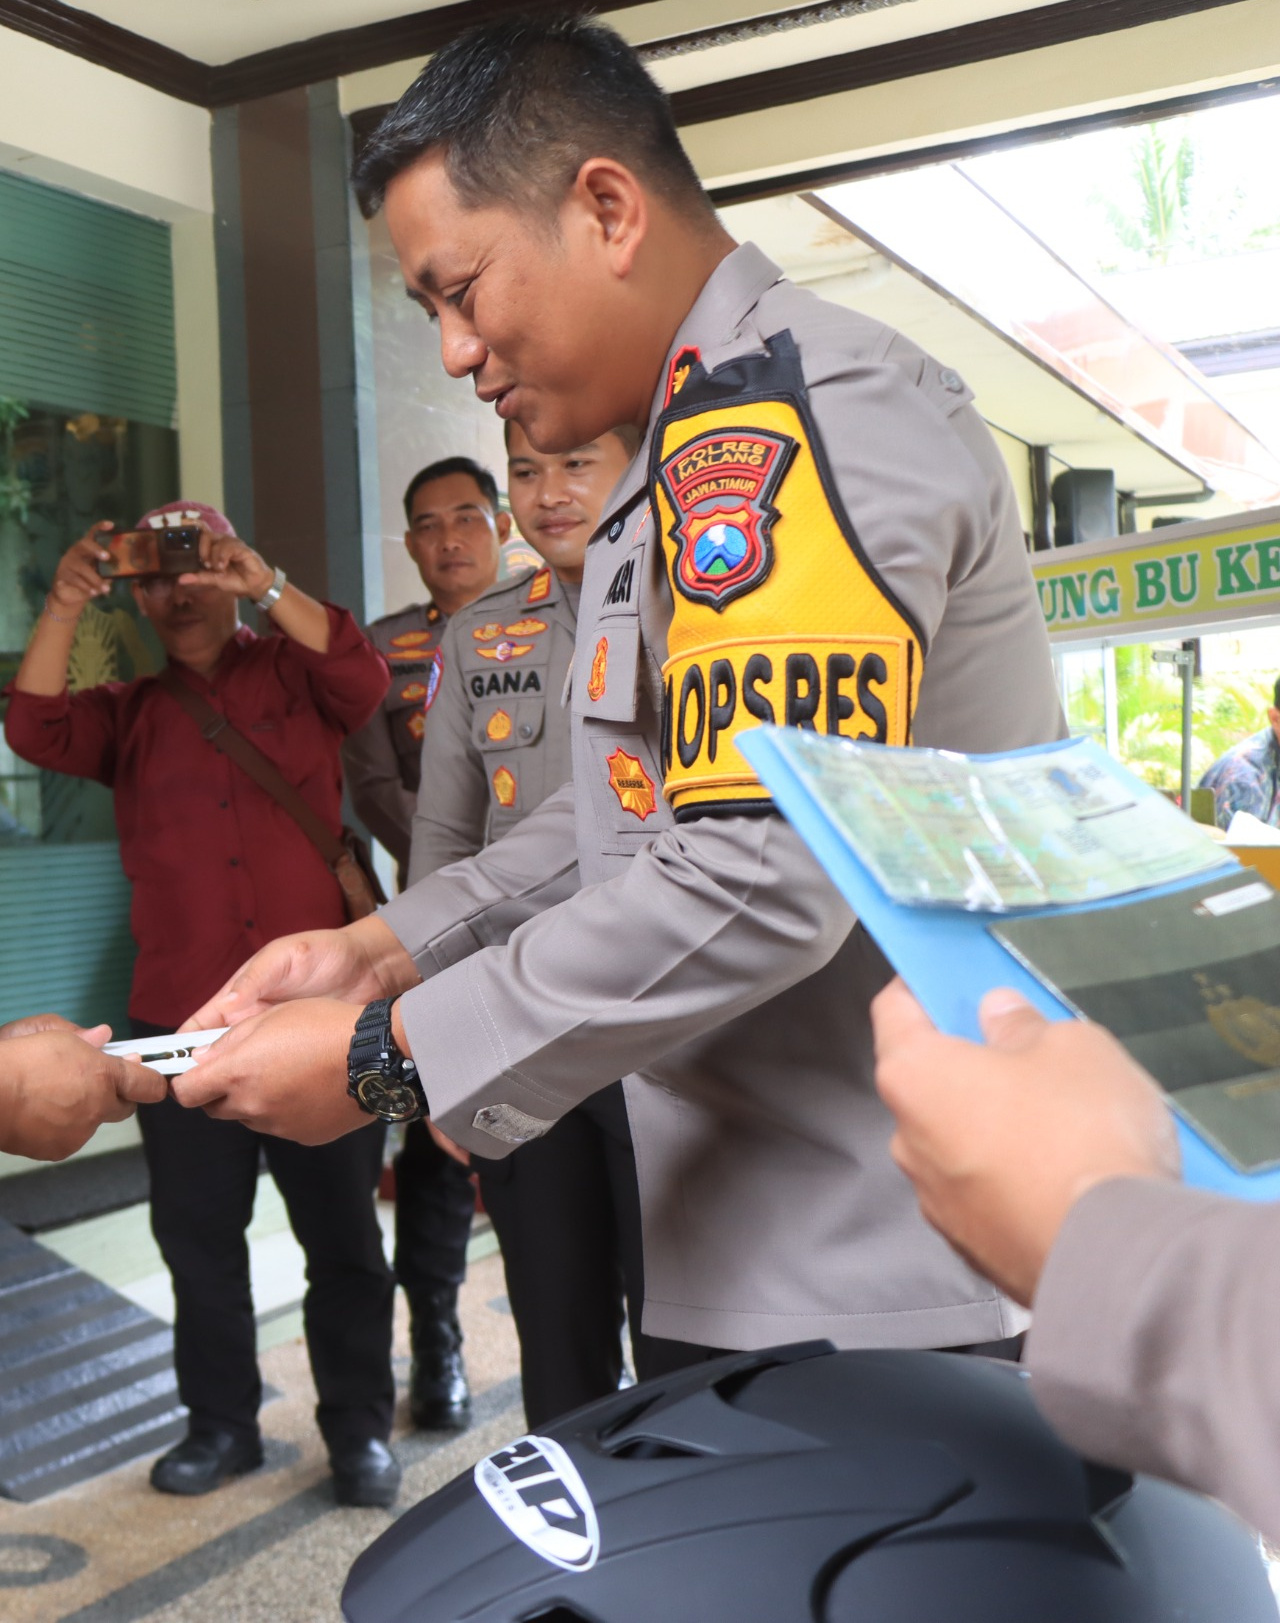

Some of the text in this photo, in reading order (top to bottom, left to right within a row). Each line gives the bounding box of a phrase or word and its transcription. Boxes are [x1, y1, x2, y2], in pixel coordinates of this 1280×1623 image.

[677, 441, 767, 470] POLRES
[678, 452, 763, 481] MALANG
[685, 477, 758, 503] JAWA TIMUR
[1133, 552, 1199, 608] BU
[470, 669, 542, 698] GANA
